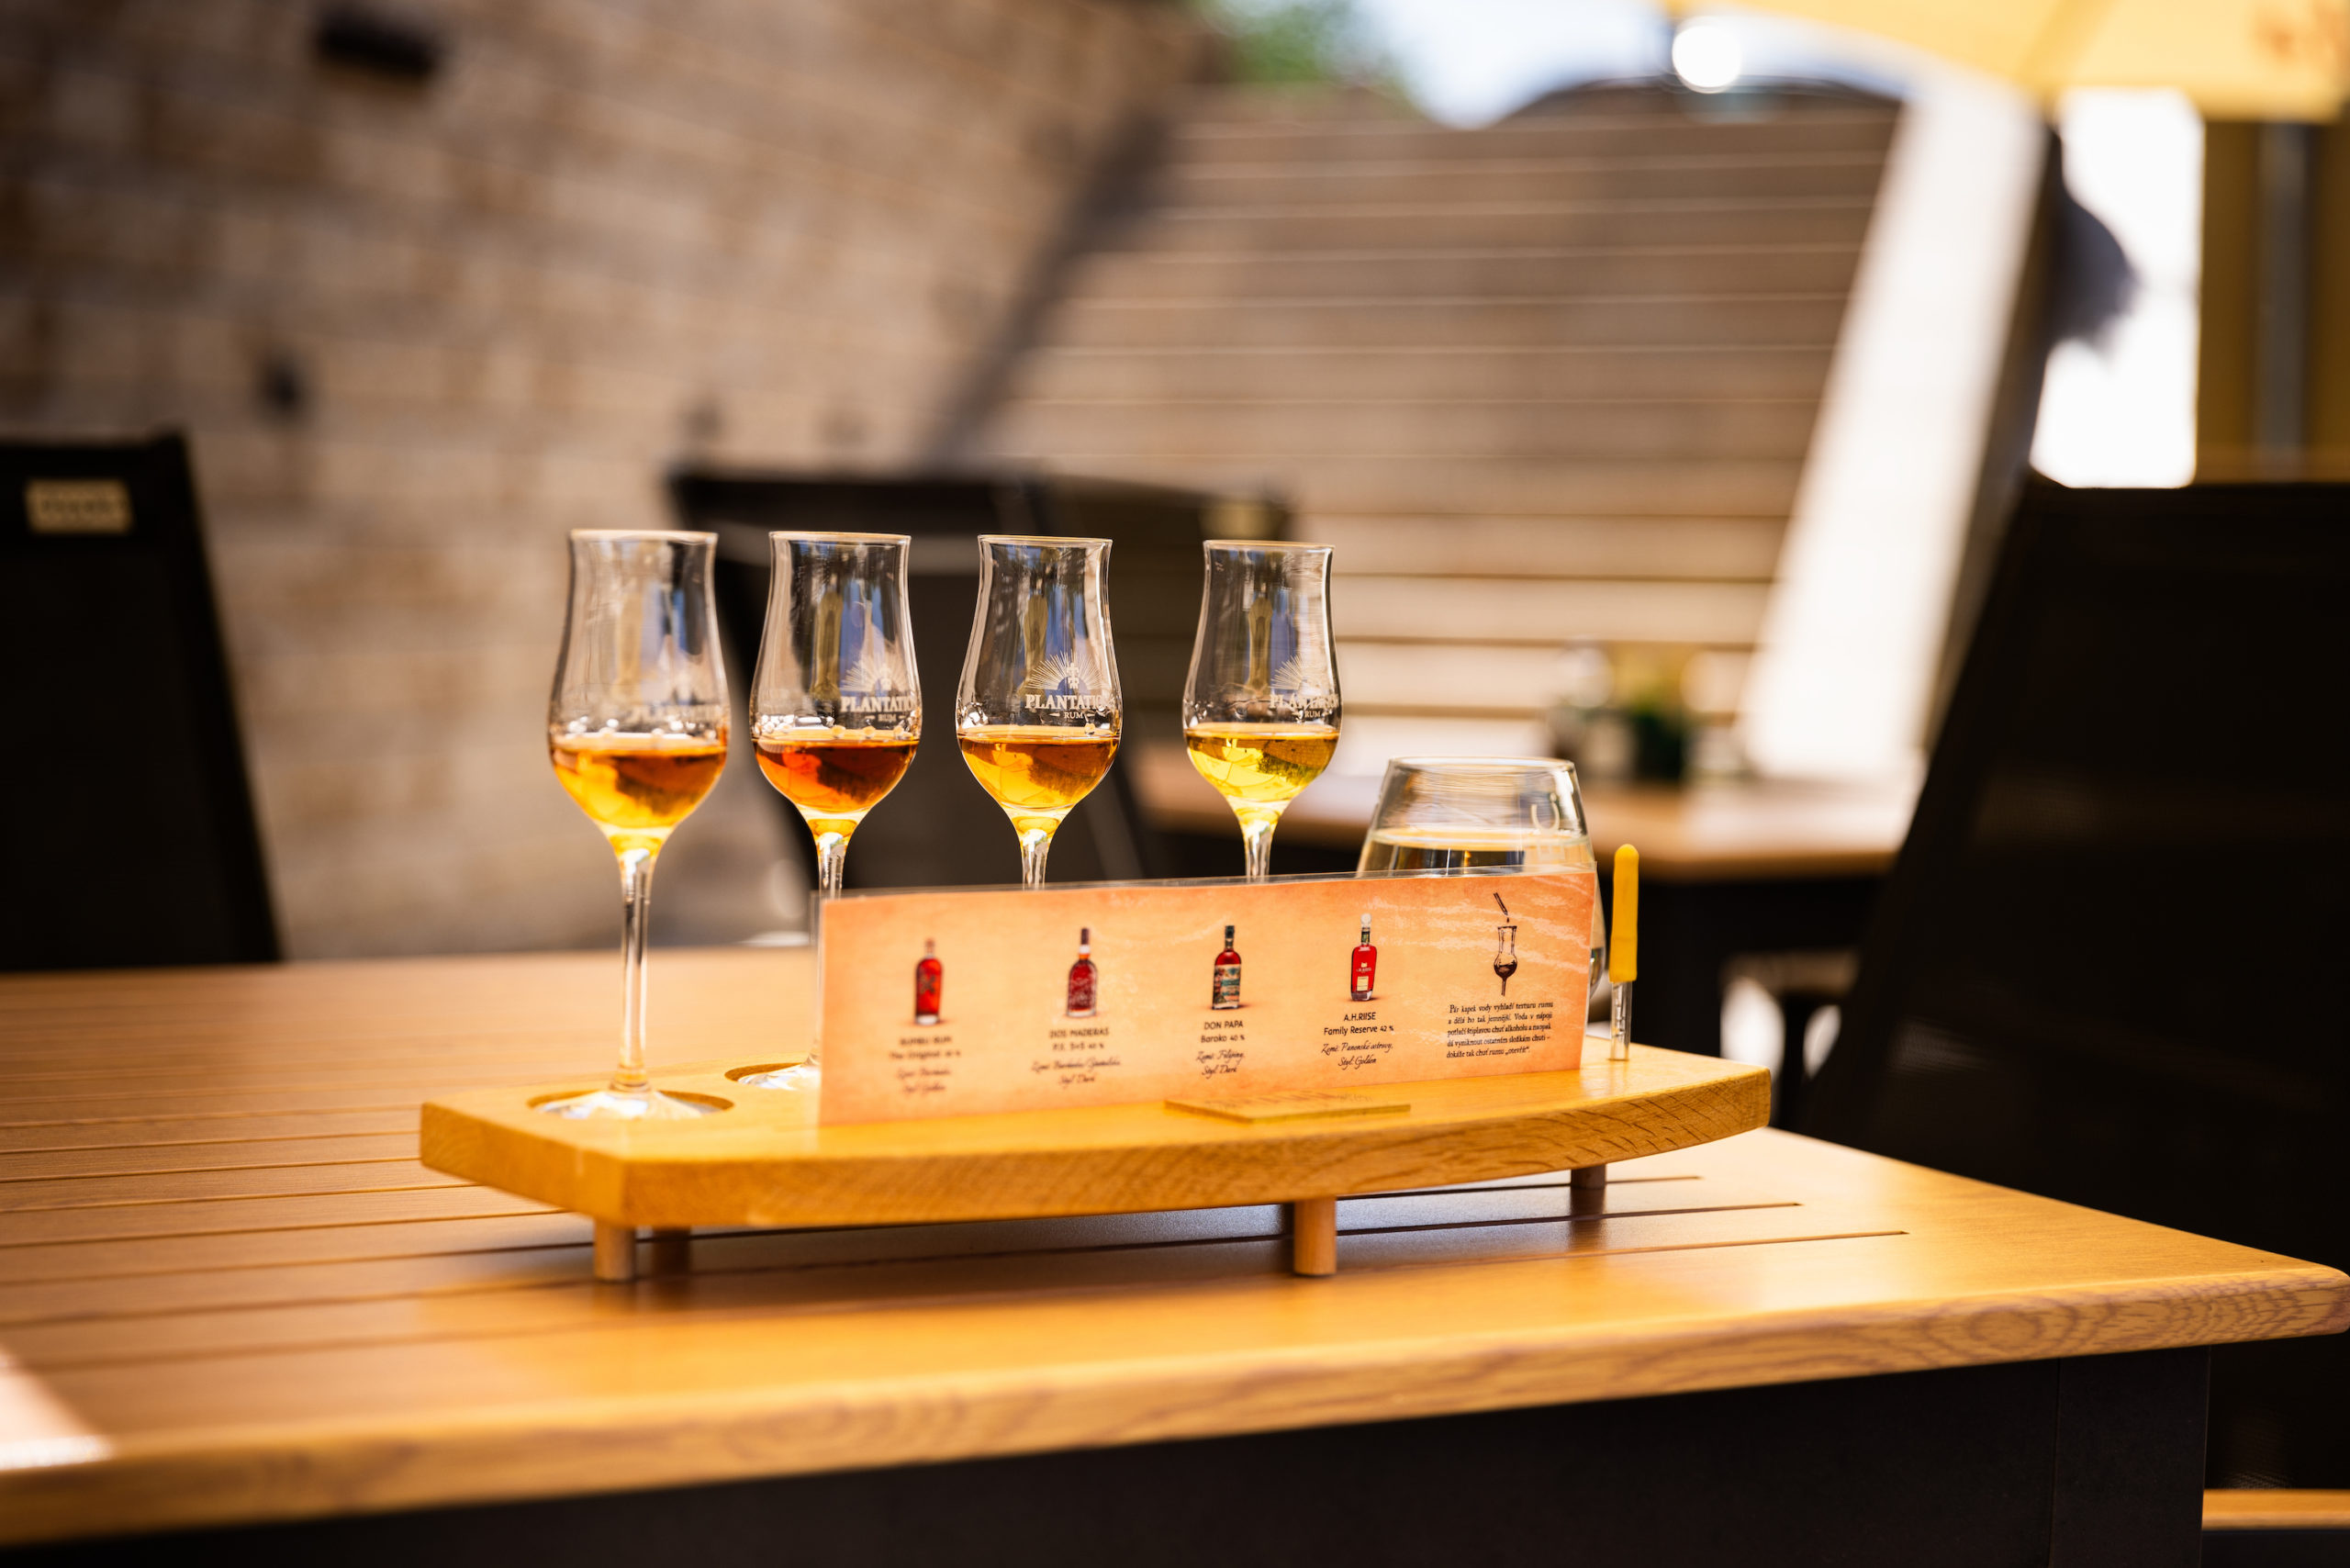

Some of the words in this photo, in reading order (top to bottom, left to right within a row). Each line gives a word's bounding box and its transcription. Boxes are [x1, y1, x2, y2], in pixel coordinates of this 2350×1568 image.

[1449, 1004, 1459, 1014] Pár
[1461, 1004, 1476, 1014] kapek
[1479, 1003, 1492, 1013] vody
[1344, 1012, 1377, 1022] A.H.RIISE
[1204, 1022, 1222, 1030] DON
[1225, 1020, 1244, 1028] PAPA
[1505, 1024, 1528, 1032] alkoholu
[1532, 1023, 1551, 1032] naopak
[1324, 1026, 1348, 1036] Family
[1350, 1025, 1378, 1034] Reserve
[1201, 1035, 1227, 1043] Baroko
[1466, 1048, 1474, 1057] tak
[1354, 1053, 1377, 1070] Golden
